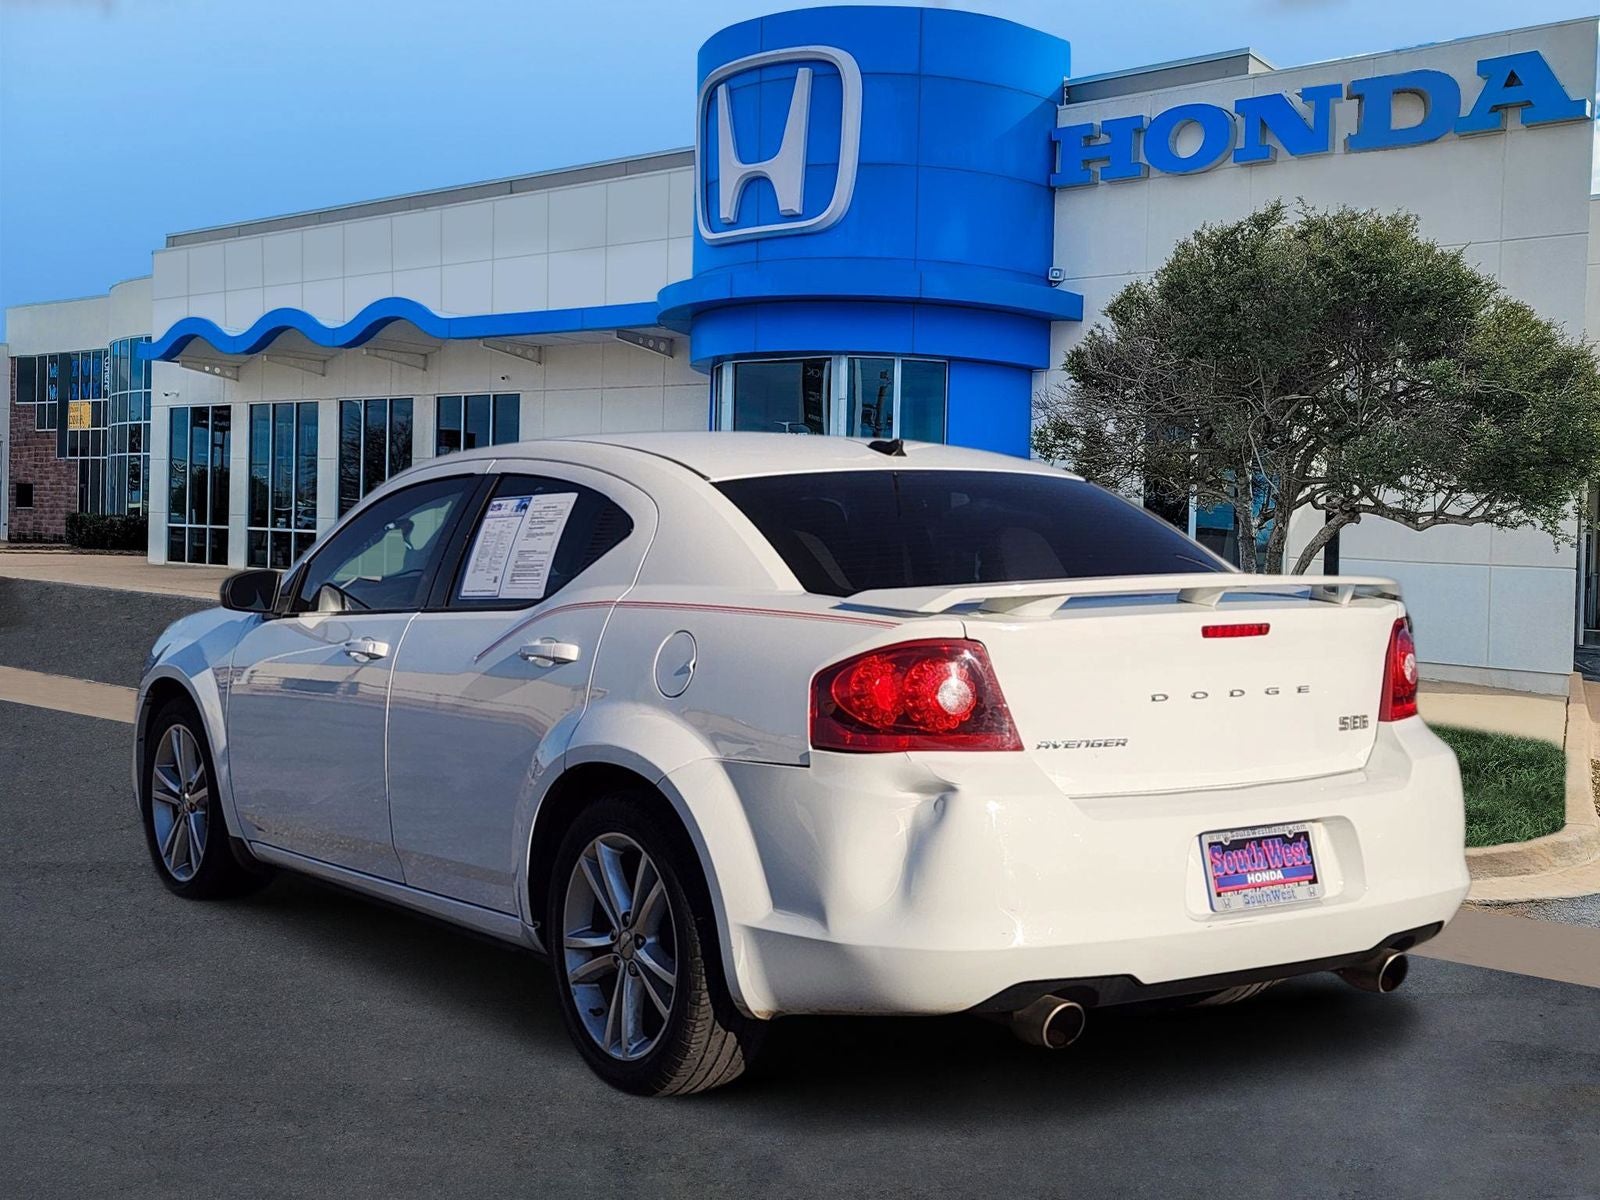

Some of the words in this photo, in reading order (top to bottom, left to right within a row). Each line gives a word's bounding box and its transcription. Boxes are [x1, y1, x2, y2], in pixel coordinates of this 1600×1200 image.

[1051, 50, 1591, 188] HONDA
[1151, 685, 1310, 702] DODGE
[1036, 738, 1129, 750] AVENGER
[1246, 869, 1285, 884] HONDA
